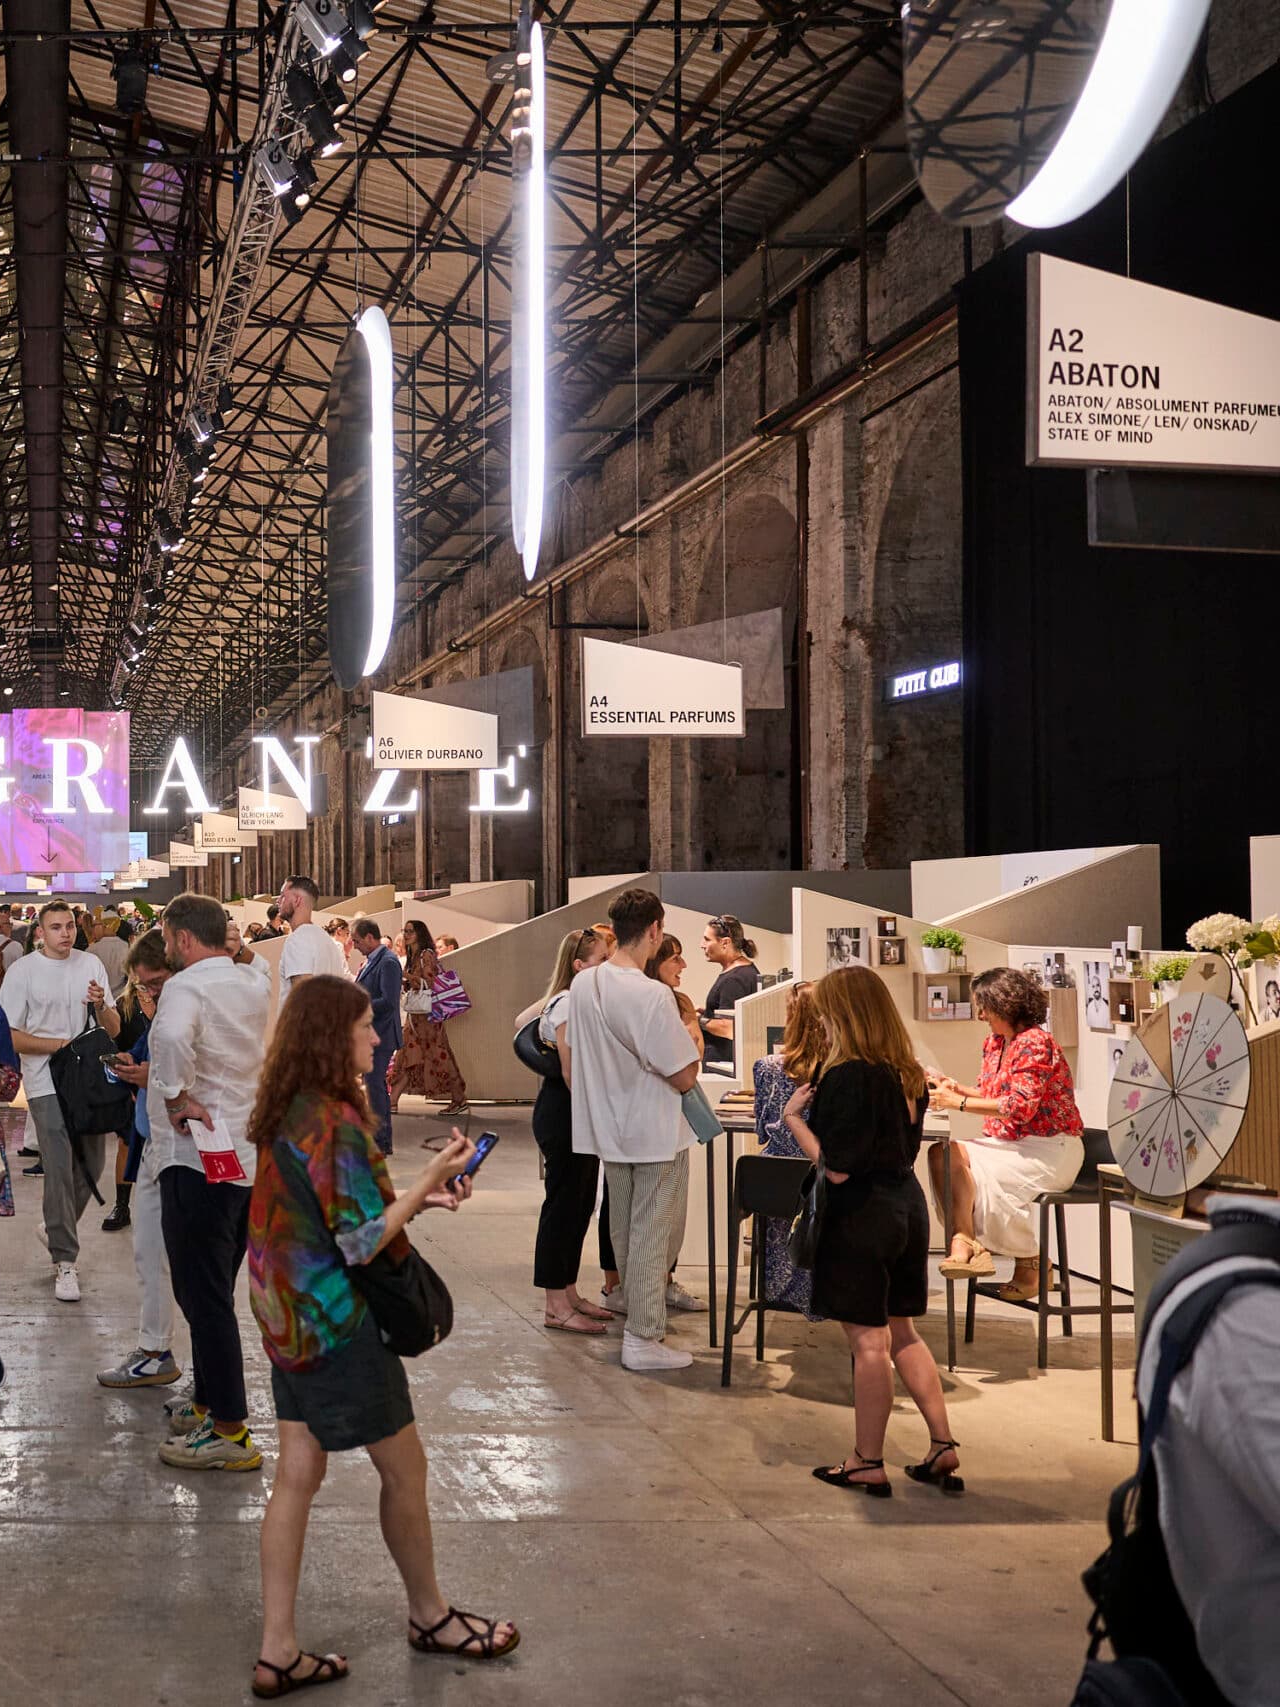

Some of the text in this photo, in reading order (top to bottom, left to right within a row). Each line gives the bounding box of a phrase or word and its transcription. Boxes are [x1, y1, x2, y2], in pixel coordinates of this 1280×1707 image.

[1048, 328, 1084, 353] A2
[1048, 361, 1160, 390] ABATON
[1047, 394, 1280, 417] ABATON/ ABSOLUMENT PARFUME
[1047, 411, 1258, 435] ALEX SIMONE/ LEN/ ONSKAD/
[1047, 427, 1153, 444] STATE OF MIND
[929, 662, 960, 689] CLUB
[589, 695, 609, 708] A4
[590, 711, 736, 724] ESSENTIAL PARFUMS
[378, 737, 394, 747] A6
[378, 749, 484, 760] OLIVIER DURBANO
